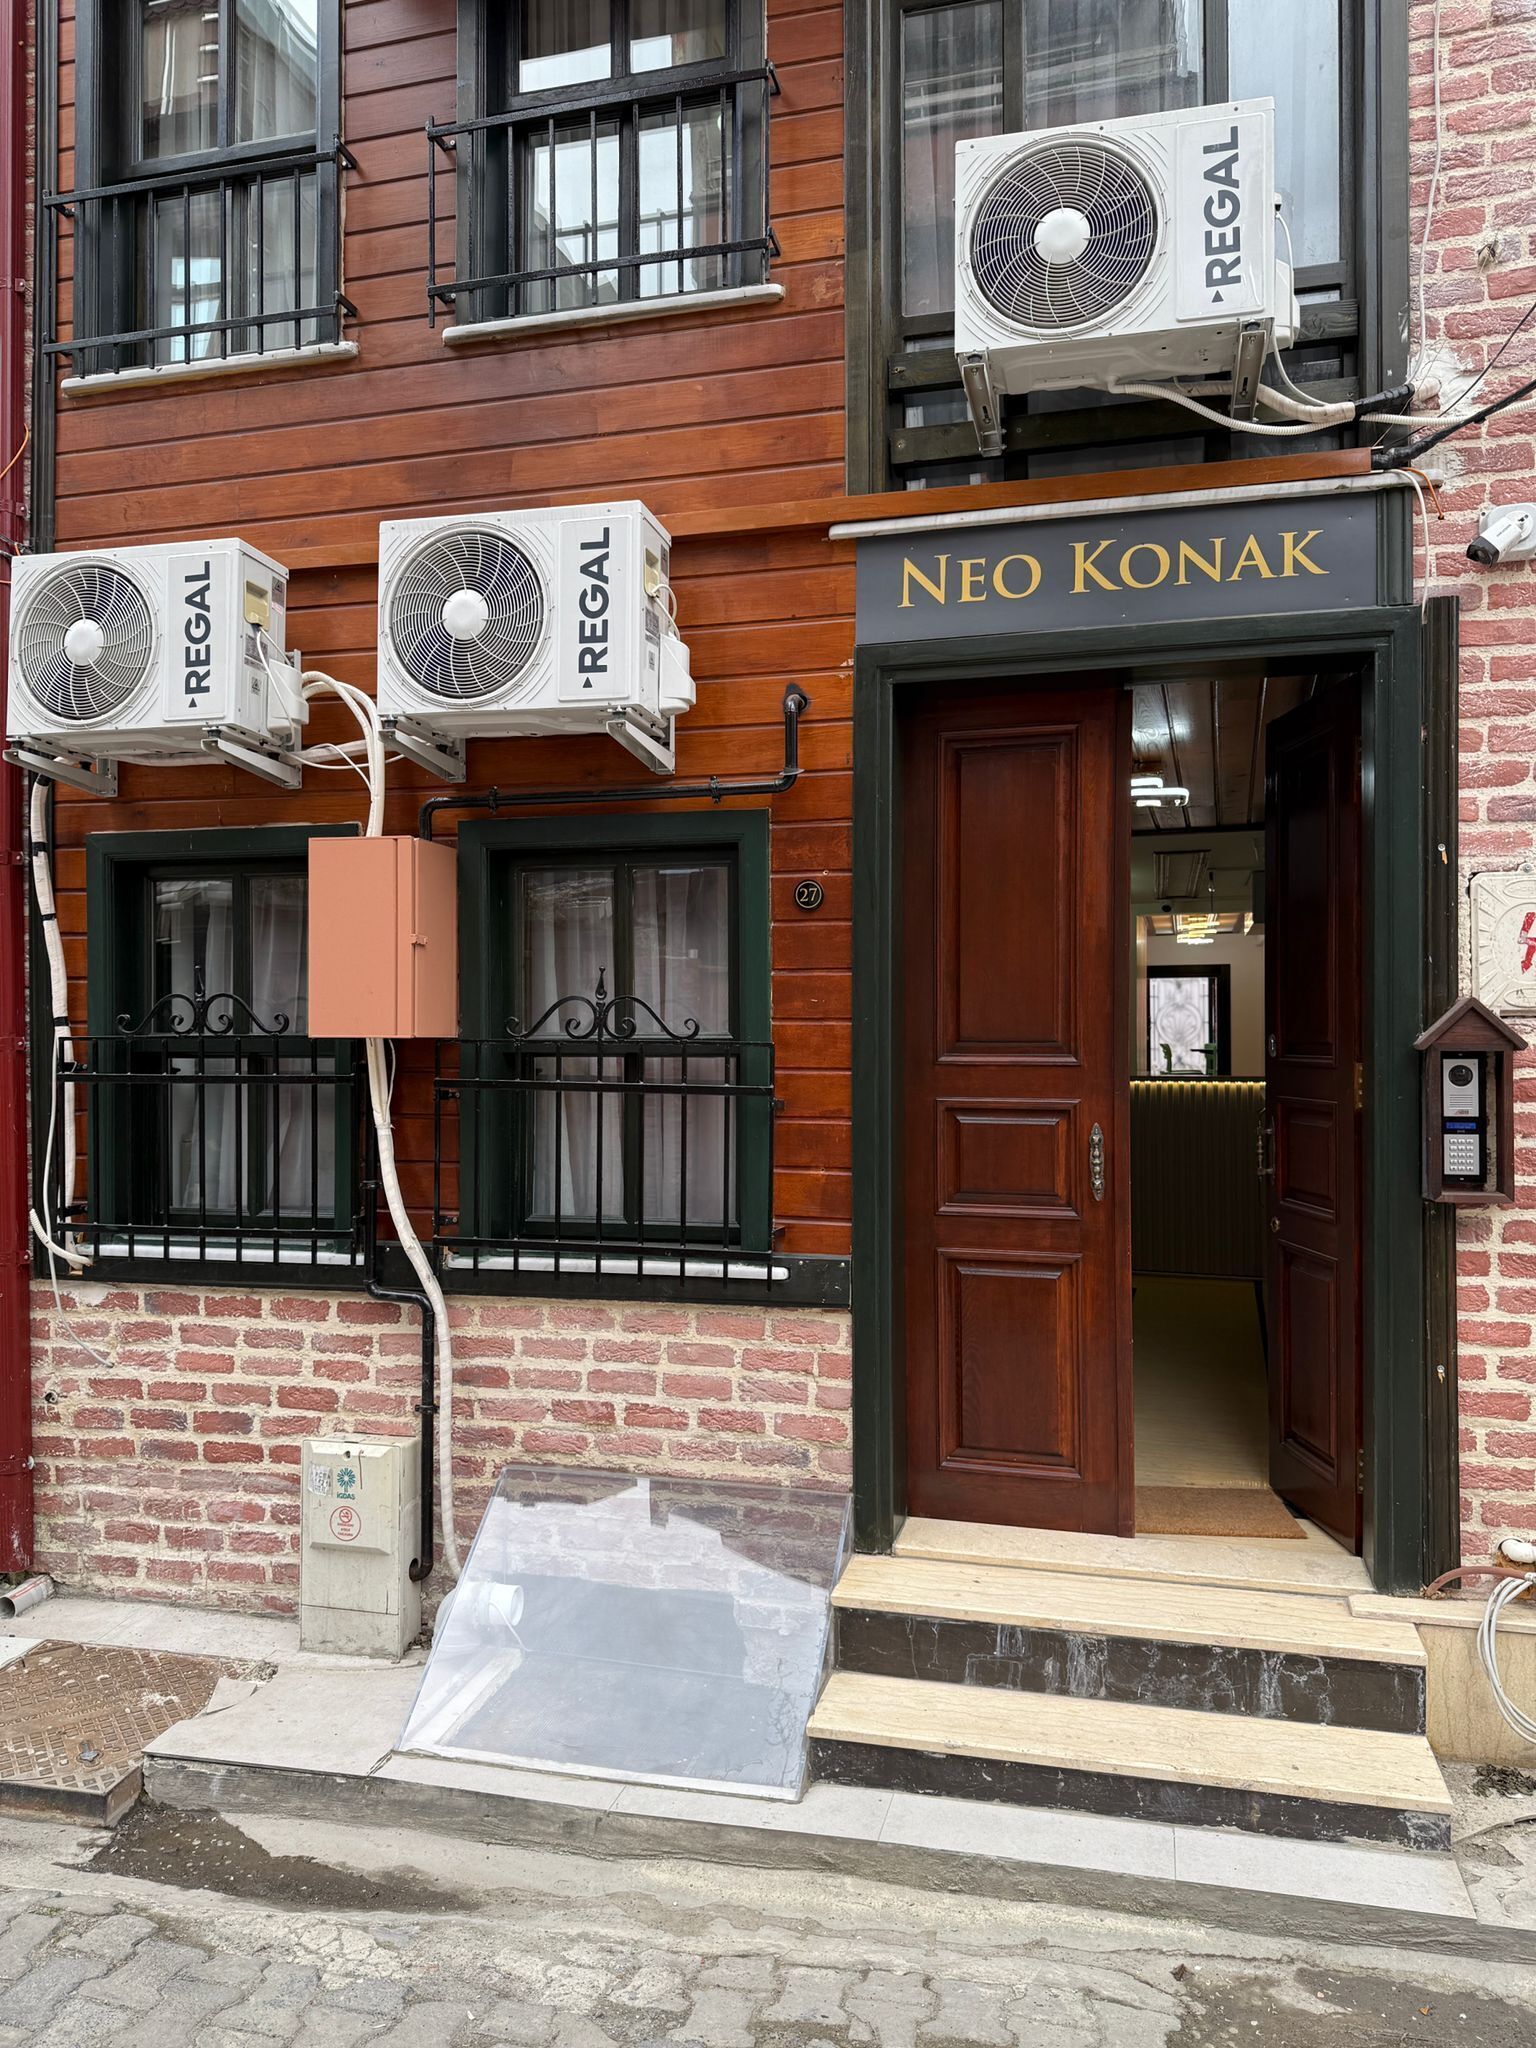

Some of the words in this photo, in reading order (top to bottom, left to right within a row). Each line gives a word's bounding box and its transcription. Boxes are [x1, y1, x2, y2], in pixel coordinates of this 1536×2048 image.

[1203, 126, 1241, 288] REGAL
[184, 560, 211, 695] REGAL
[579, 527, 610, 674] REGAL
[897, 553, 1042, 608] NEO
[1070, 530, 1330, 594] KONAK
[799, 888, 818, 902] 27
